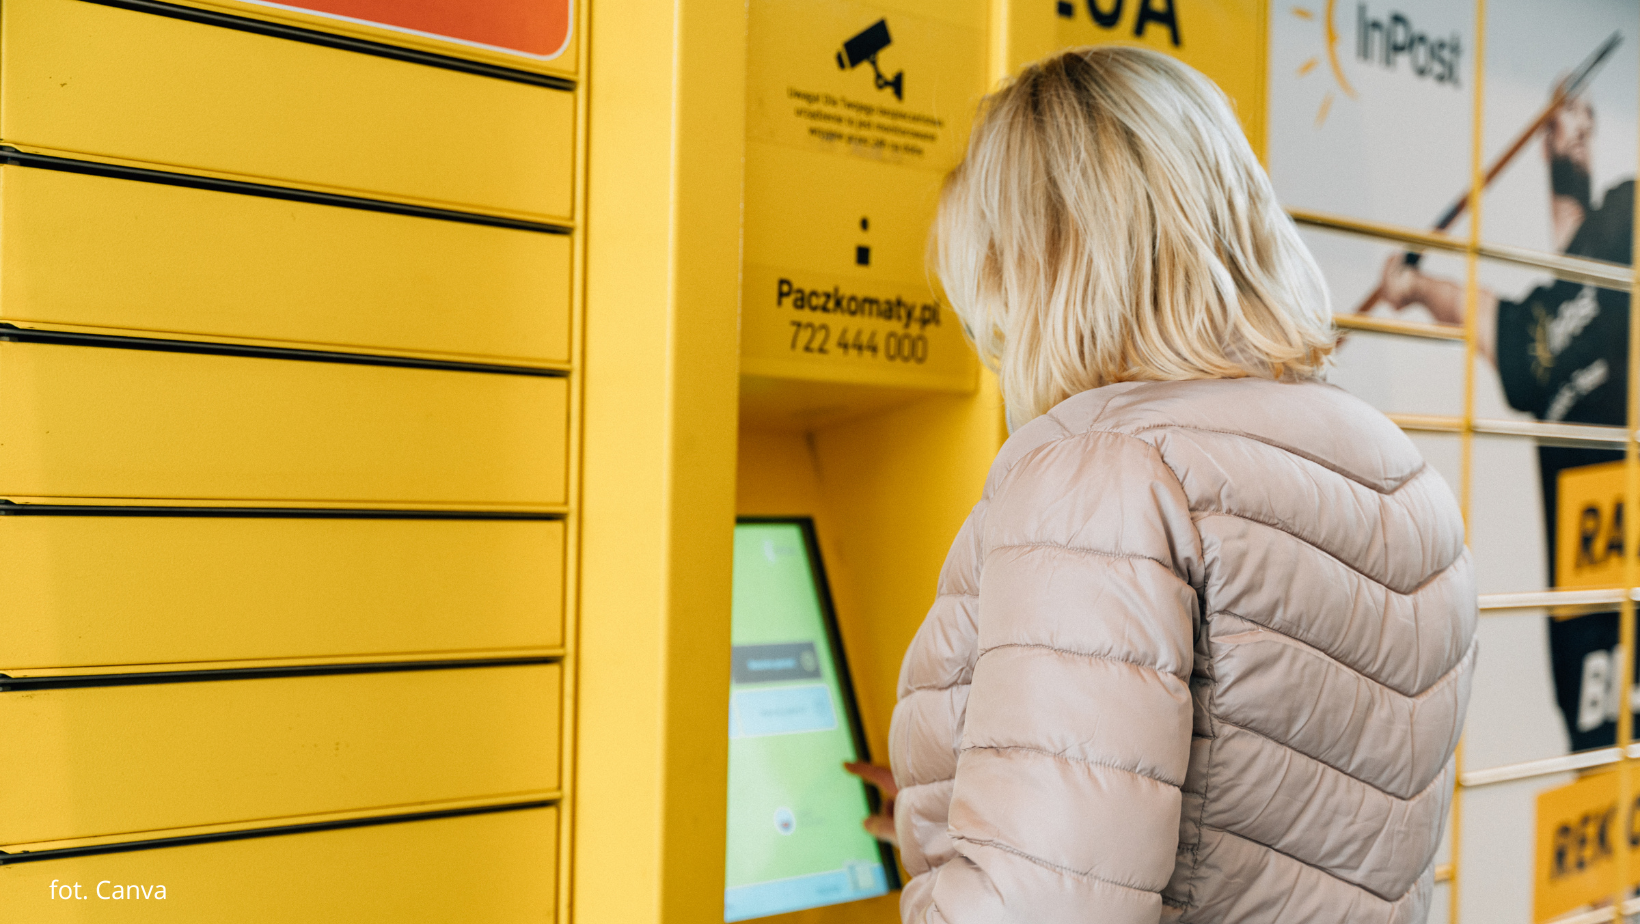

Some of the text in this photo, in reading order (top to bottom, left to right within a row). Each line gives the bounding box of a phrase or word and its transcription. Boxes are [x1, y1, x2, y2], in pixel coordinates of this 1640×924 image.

[1357, 4, 1462, 86] InPost
[776, 278, 942, 329] Paczkomaty.pl
[789, 320, 929, 364] 722 444 000
